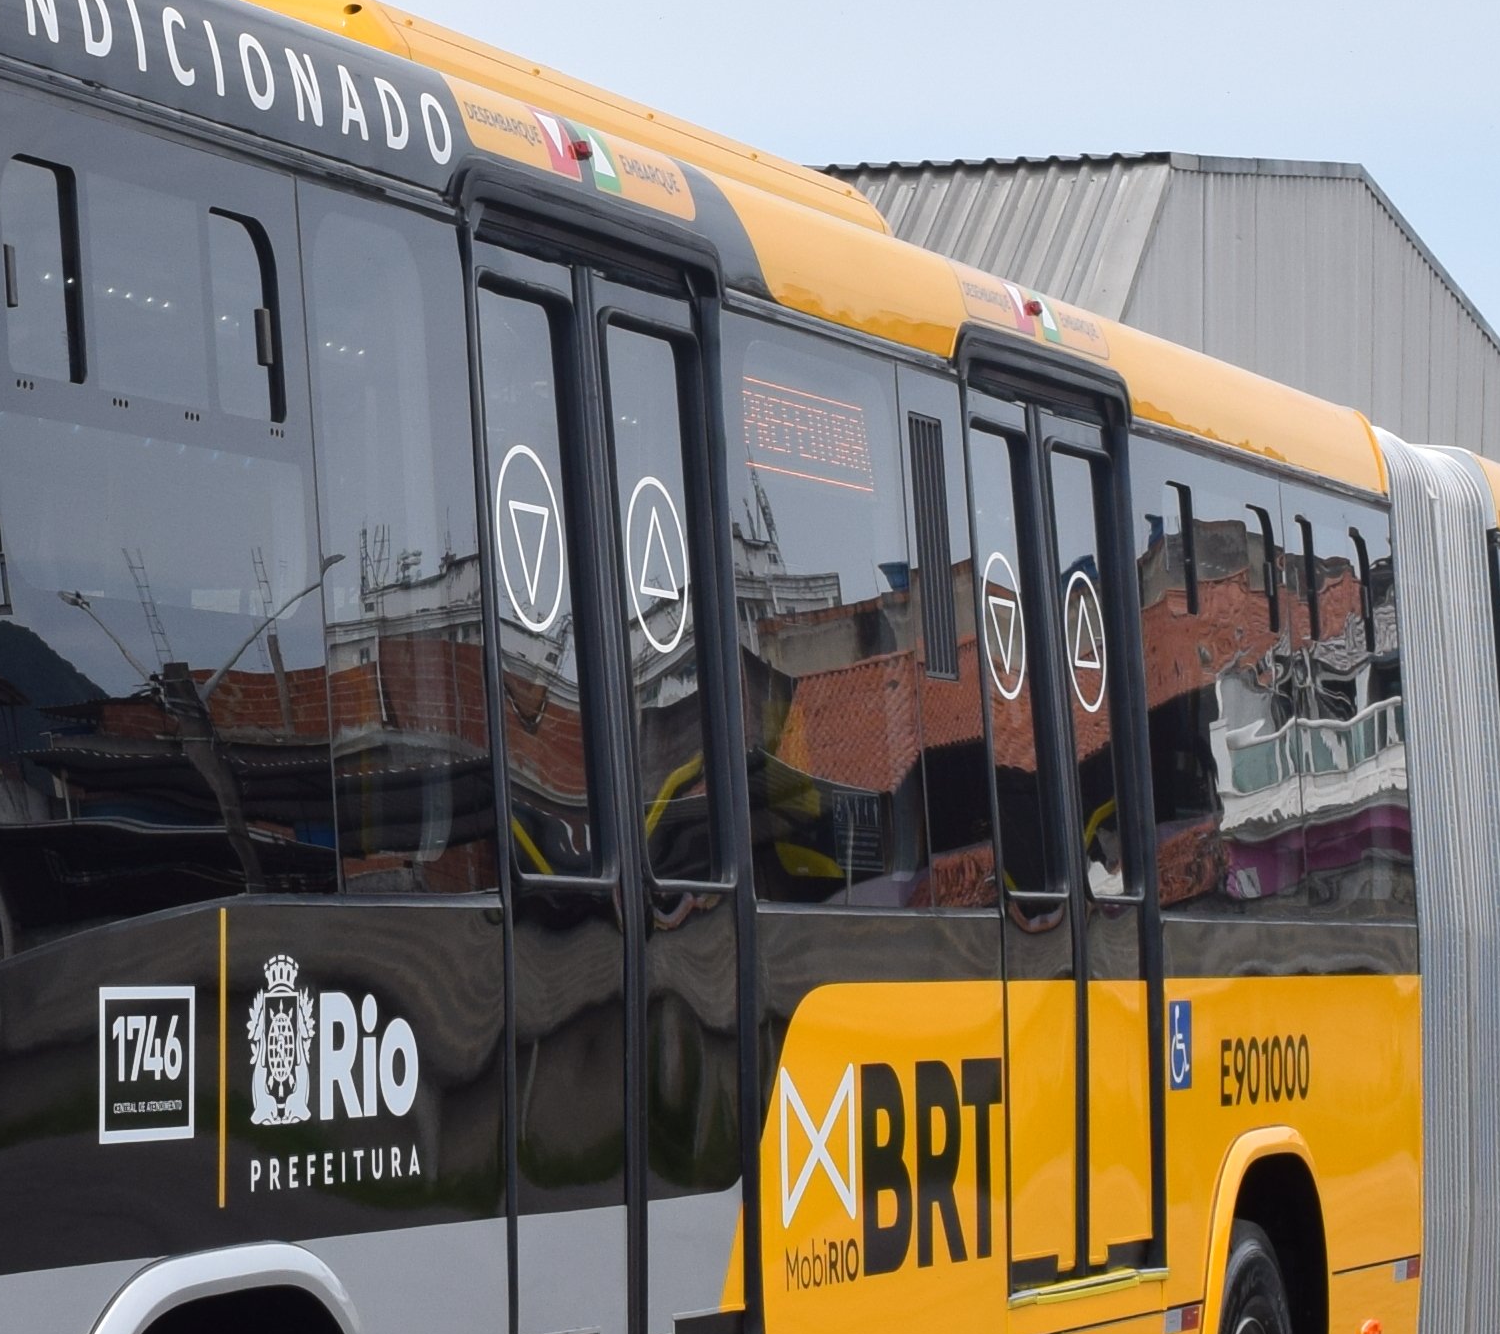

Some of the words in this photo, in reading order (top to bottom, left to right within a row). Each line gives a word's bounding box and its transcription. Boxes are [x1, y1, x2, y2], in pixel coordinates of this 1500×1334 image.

[463, 101, 543, 147] DESEMBARQUE
[619, 154, 681, 195] EMBARQUE
[112, 1015, 183, 1082] 1746
[319, 992, 419, 1120] Rio
[1220, 1034, 1310, 1107] E901000
[250, 1143, 421, 1193] PREFEITURA
[860, 1057, 1003, 1277] BRT
[785, 1237, 860, 1293] MobiRIO
